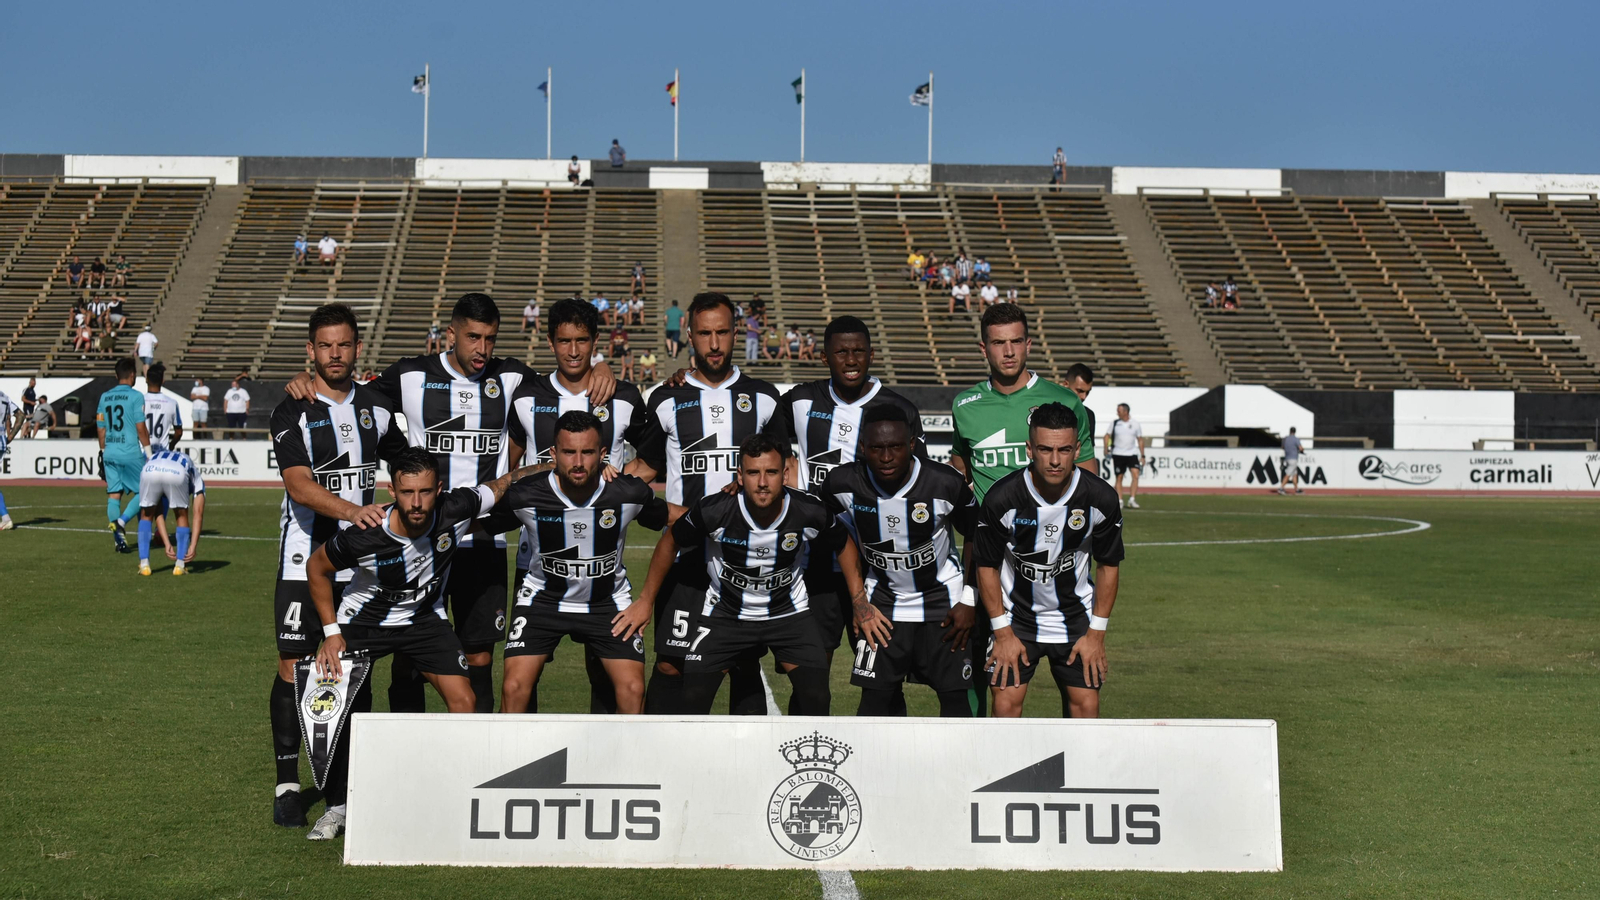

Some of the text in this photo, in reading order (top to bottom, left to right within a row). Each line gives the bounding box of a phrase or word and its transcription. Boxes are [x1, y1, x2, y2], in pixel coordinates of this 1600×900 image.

[420, 382, 450, 390] LEGEA
[105, 404, 124, 432] 13
[146, 413, 165, 439] 16
[305, 418, 332, 429] LEGEA
[806, 410, 833, 420] LEGEA
[425, 433, 501, 454] LOTUS
[681, 453, 741, 476] LOTU
[973, 447, 1034, 468] LOTU
[1158, 457, 1241, 470] El Guadarnés
[1469, 465, 1552, 484] carmali
[849, 503, 877, 514] LEGEA
[540, 556, 618, 579] LOTUS
[863, 546, 937, 571] LOTUS
[1013, 551, 1077, 584] OTUS
[719, 567, 794, 591] LOTUS
[284, 601, 302, 631] 4
[508, 616, 527, 640] 3
[672, 609, 690, 639] 5
[279, 632, 306, 641] LEGEA
[690, 625, 711, 652] 7
[854, 639, 878, 672] 11
[770, 772, 859, 826] REAL BALOMPEDICA
[469, 797, 661, 841] LOTUS
[970, 802, 1161, 845] LOTUS
[789, 842, 844, 859] LINENSE
